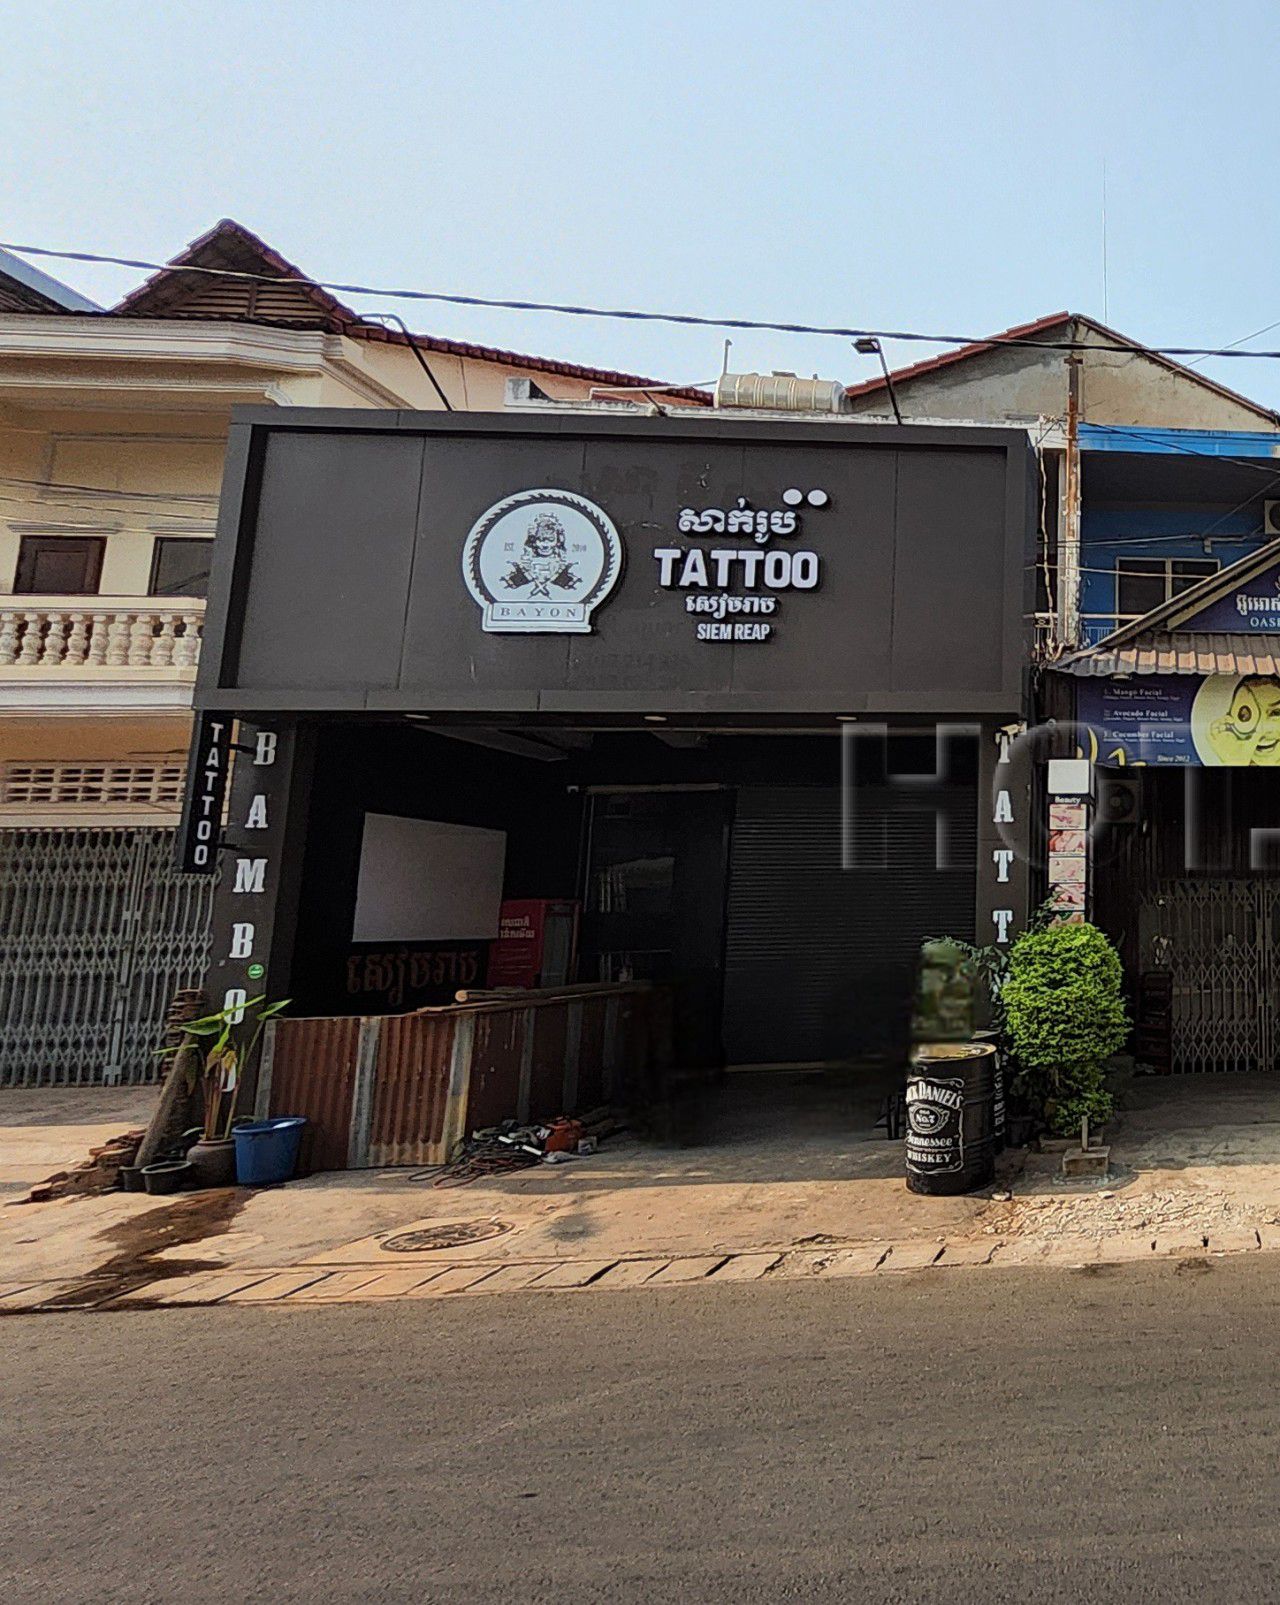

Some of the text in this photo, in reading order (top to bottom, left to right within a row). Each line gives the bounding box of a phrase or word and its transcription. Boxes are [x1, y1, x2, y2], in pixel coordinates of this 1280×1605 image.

[654, 549, 818, 589] TATTOO
[501, 607, 576, 617] BAYON
[686, 593, 776, 619] សៀមរាប
[697, 623, 770, 640] SIEM REAP
[1113, 688, 1138, 697] Mango
[1140, 688, 1162, 696] Facial
[194, 722, 225, 866] TATTOO
[1055, 796, 1081, 807] Beauty
[906, 1129, 953, 1147] Tennessee
[906, 1150, 952, 1163] WHISKEY
